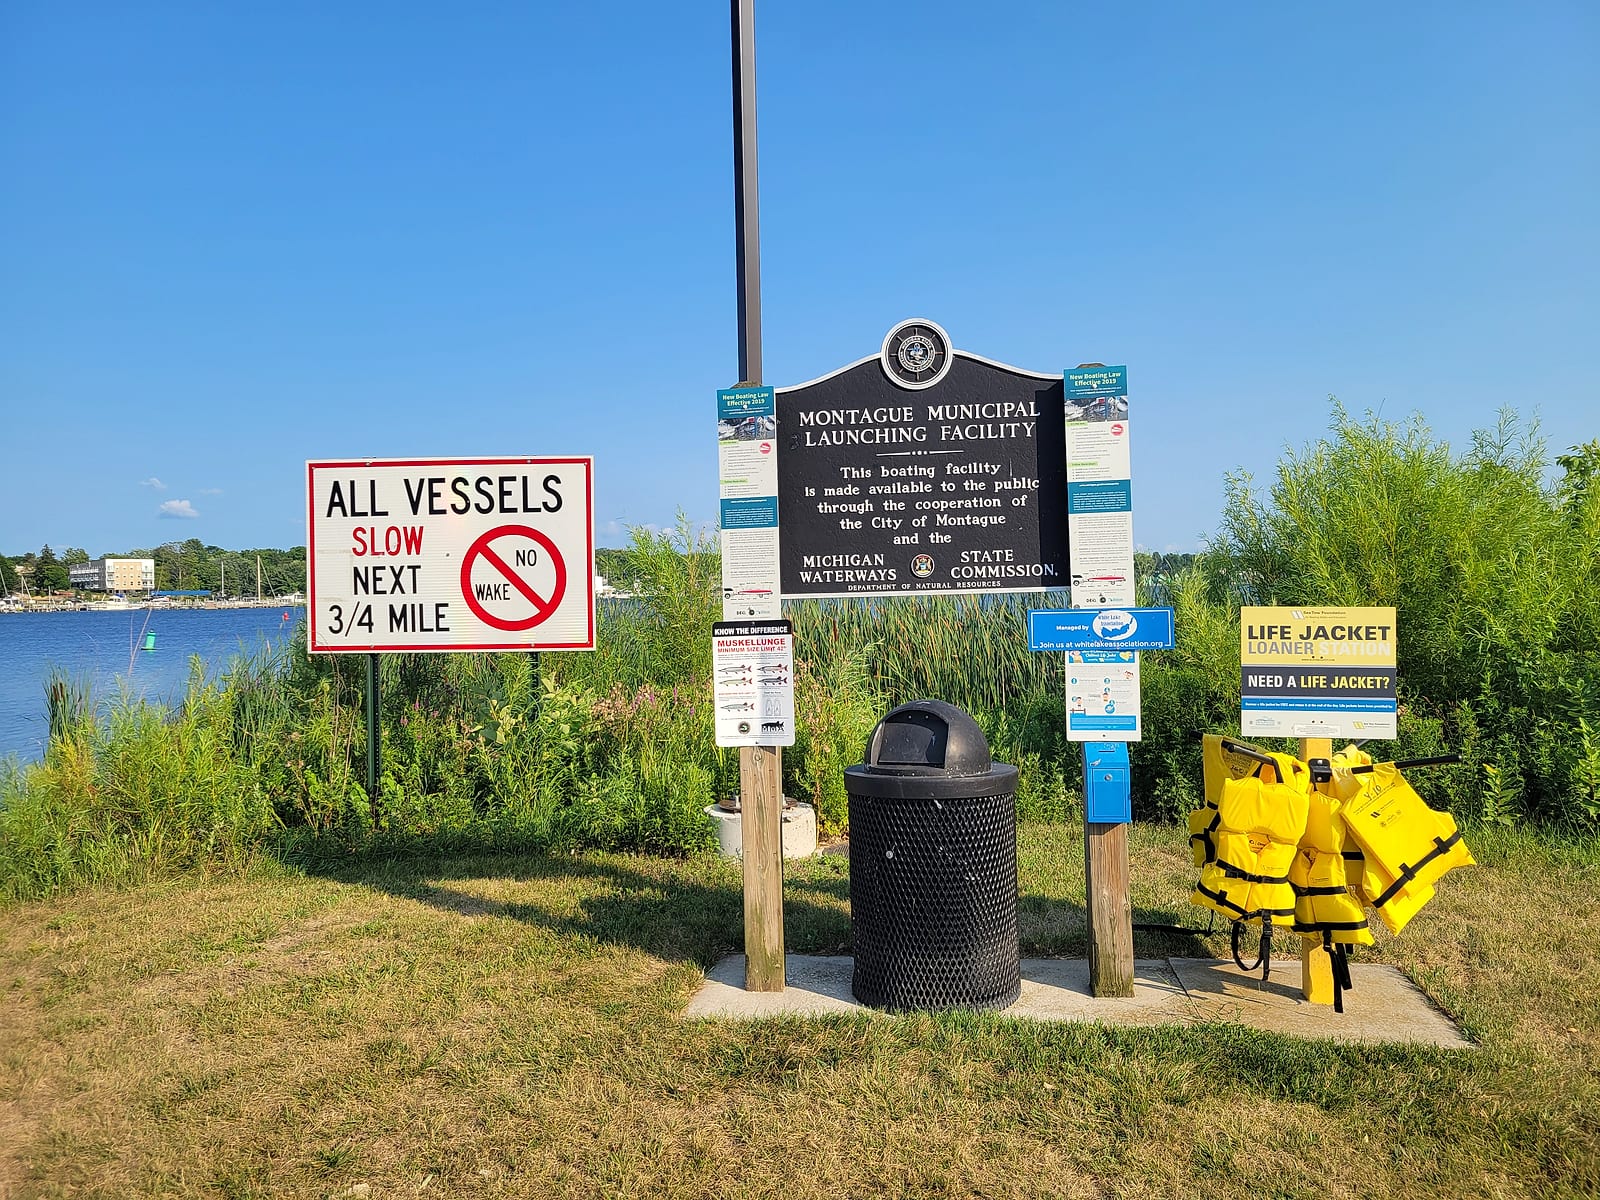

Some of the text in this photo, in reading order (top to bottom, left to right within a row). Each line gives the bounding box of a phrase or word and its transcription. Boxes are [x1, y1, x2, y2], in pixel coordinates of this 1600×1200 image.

[800, 402, 1040, 427] MONTAGUE MUNICIPAL
[805, 422, 1036, 447] LAUNCHING FACILITY
[840, 462, 1001, 479] This boating facility
[824, 484, 860, 495] made
[868, 482, 932, 495] available
[941, 481, 955, 492] to
[964, 480, 986, 491] the
[995, 477, 1040, 491] public
[326, 475, 563, 517] ALL VESSELS
[818, 495, 1028, 514] through the cooperation of
[840, 514, 1006, 530] the City of Montague
[352, 526, 424, 557] SLOW
[893, 533, 951, 545] and the
[516, 549, 536, 567] NO
[803, 555, 884, 567] MICHIGAN
[960, 550, 1014, 563] STATE
[353, 565, 421, 595] NEXT
[800, 569, 897, 583] WATERWAYS
[475, 584, 510, 601] WAKE
[328, 601, 450, 637] 3/4 MILE
[751, 626, 787, 634] DIFFERENCE
[1248, 625, 1390, 640] LIFE JACKET
[718, 638, 785, 647] MUSKELLUNGE
[1248, 642, 1390, 656] LOANER STATION
[1248, 675, 1390, 689] NEED A LIFE JACKET?
